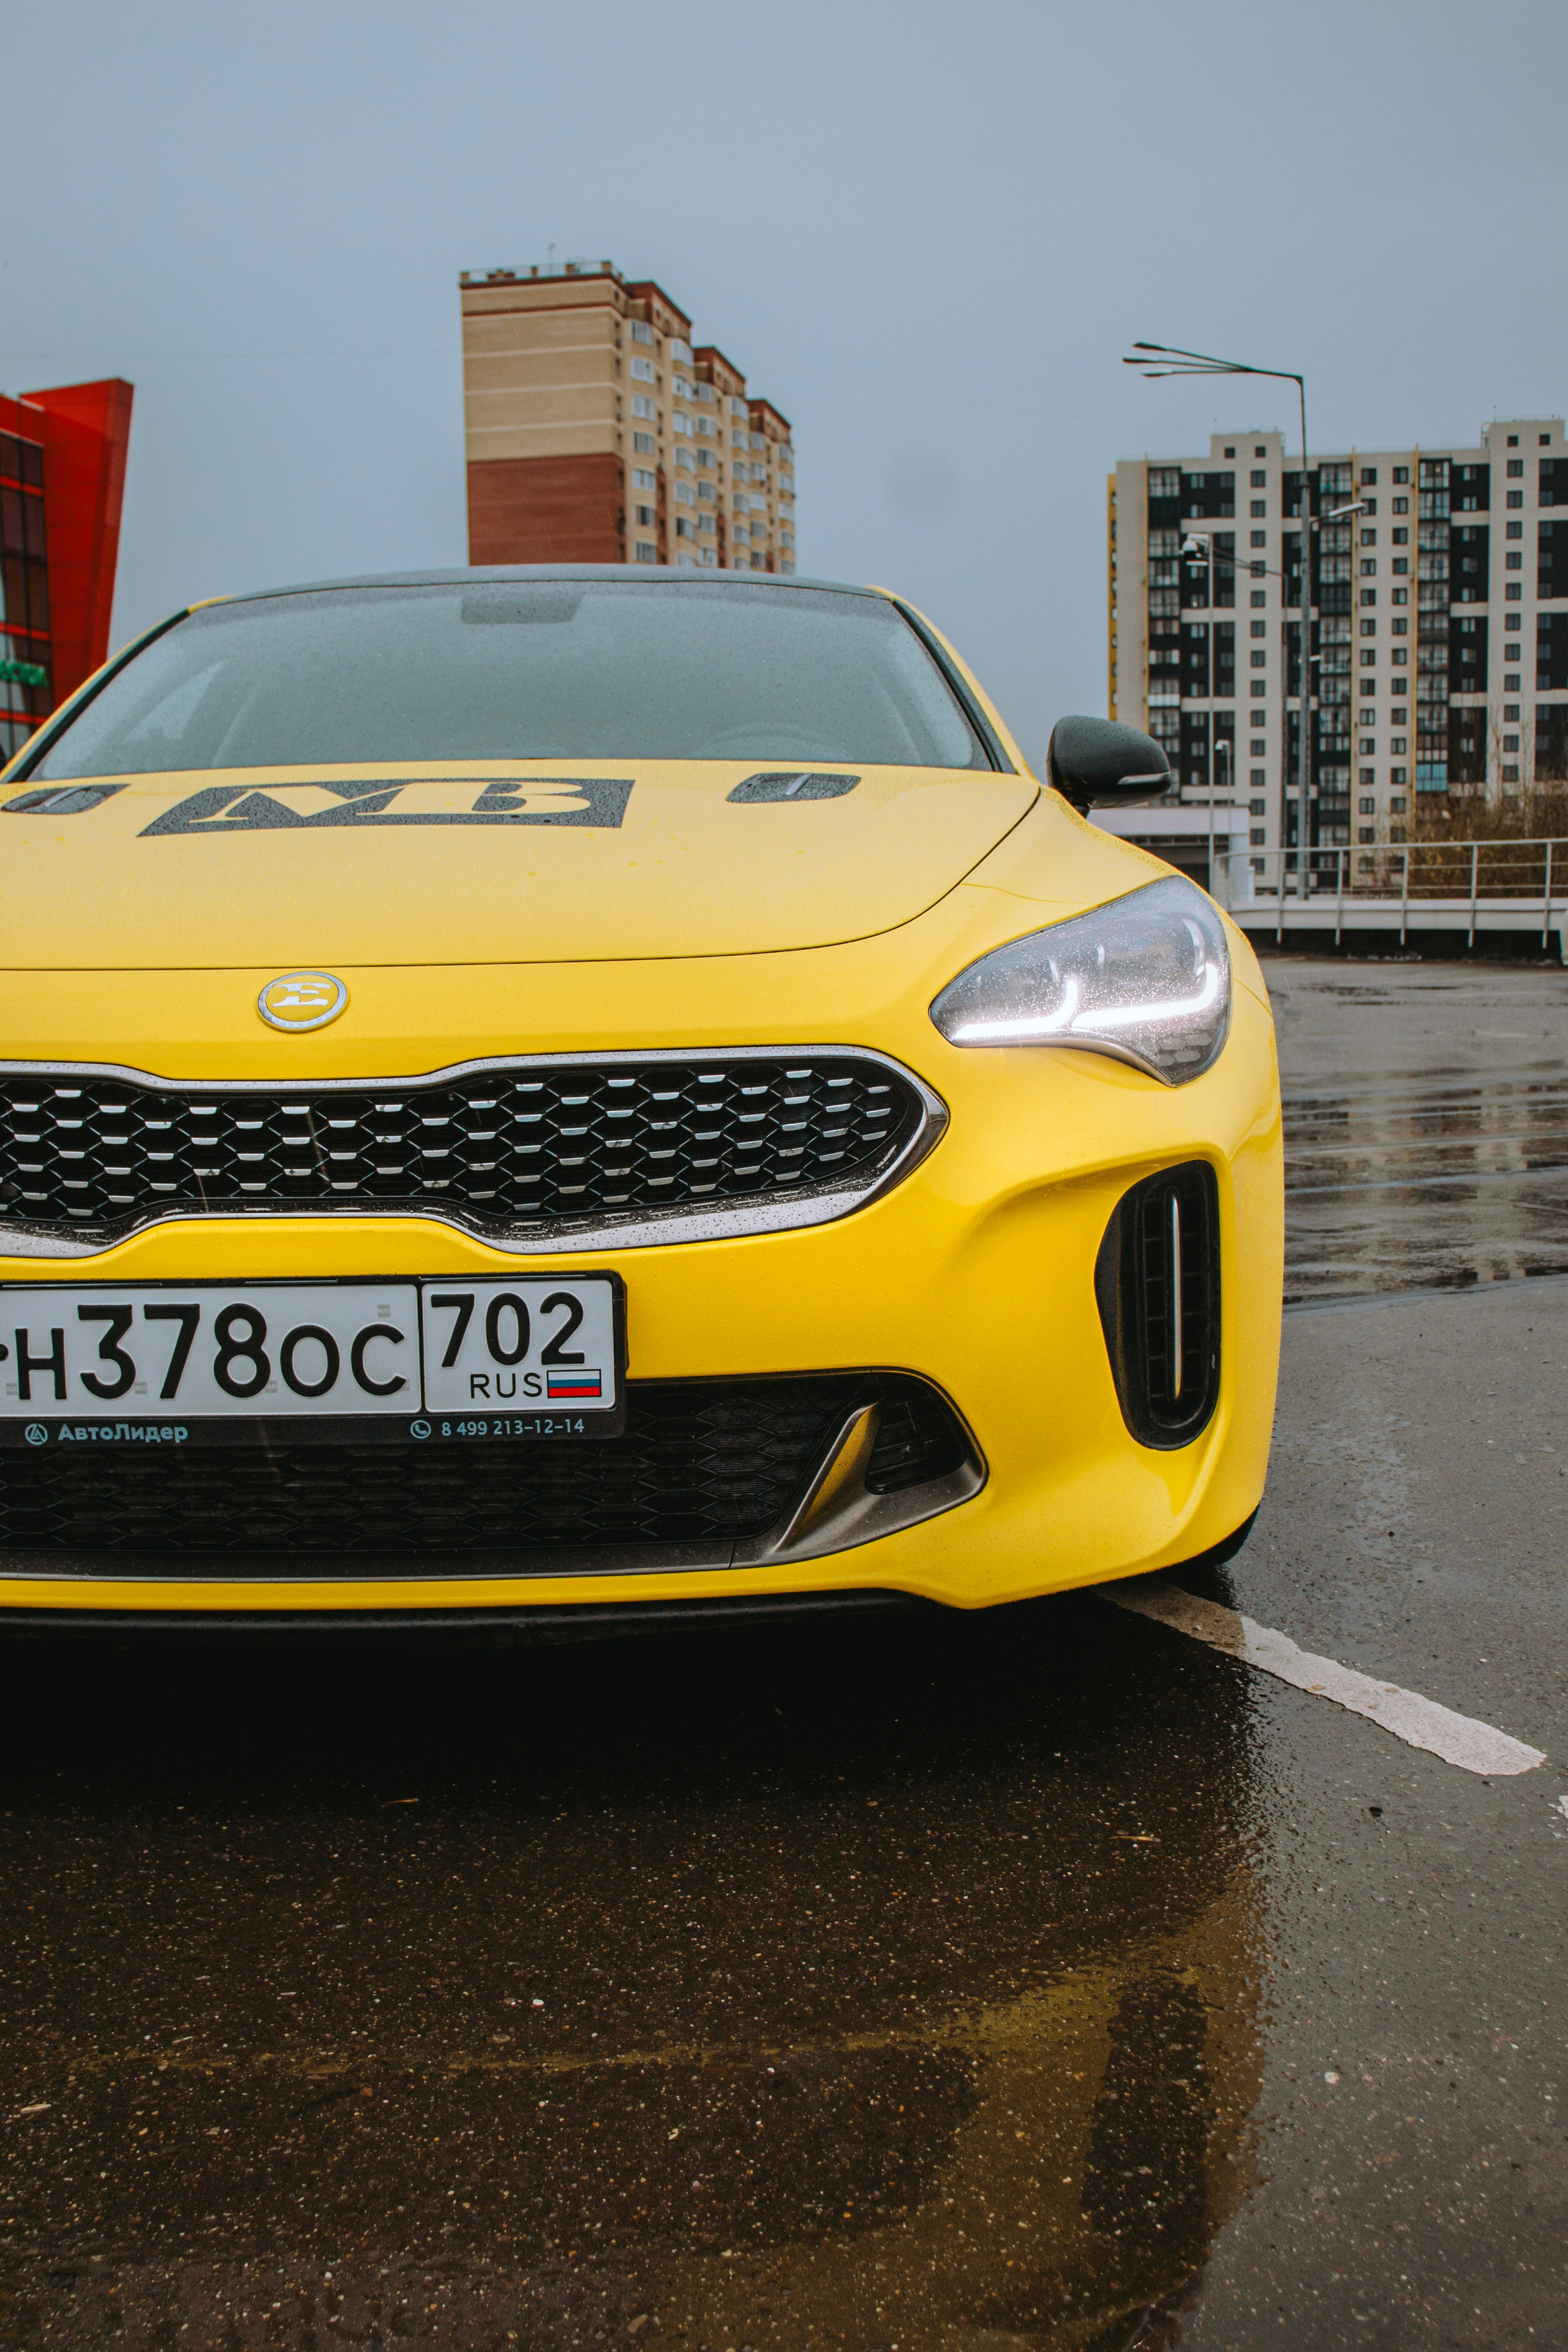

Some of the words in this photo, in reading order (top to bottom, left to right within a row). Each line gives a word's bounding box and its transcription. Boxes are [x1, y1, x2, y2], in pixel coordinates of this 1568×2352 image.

[431, 1292, 586, 1367] 702
[470, 1372, 543, 1398] RUS
[58, 1423, 189, 1443] АвтоЛидер
[441, 1422, 452, 1436] 8
[456, 1421, 488, 1436] 499
[493, 1419, 585, 1435] 213-12-14
